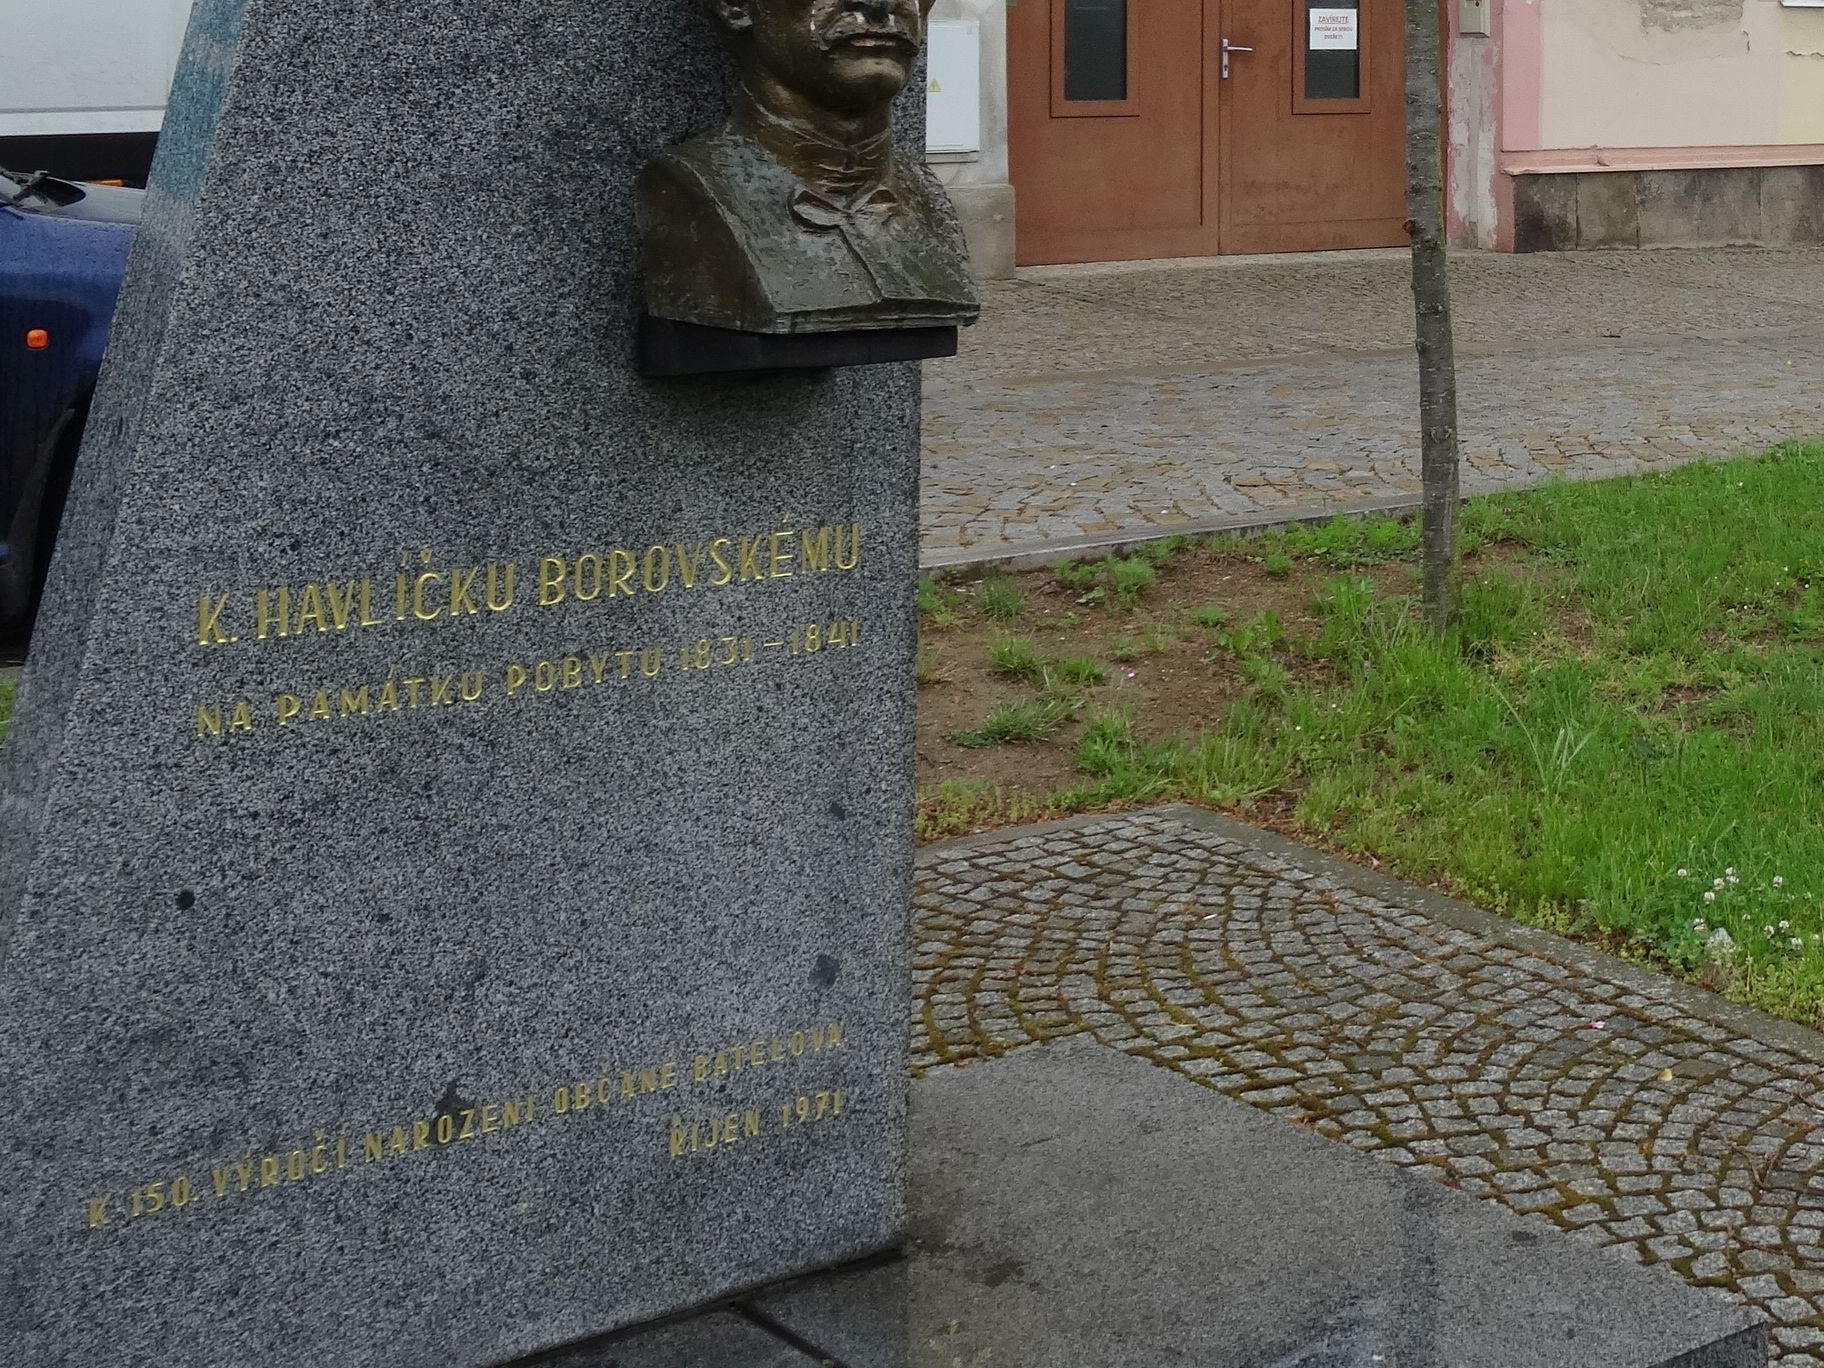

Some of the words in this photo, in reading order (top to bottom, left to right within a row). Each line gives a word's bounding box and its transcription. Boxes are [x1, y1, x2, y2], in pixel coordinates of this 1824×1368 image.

[196, 592, 239, 646] K.
[256, 548, 516, 640] HAVLÍČKU
[539, 510, 861, 606] BOROVSKÉMU
[196, 700, 252, 737] NA
[275, 664, 484, 727] PAMÁTKU
[506, 647, 662, 696] POBYTU
[86, 1193, 109, 1229] K
[210, 1121, 352, 1198] VÝROČÍ
[694, 1021, 843, 1082] BATELOVA
[781, 1088, 845, 1129] 1971
